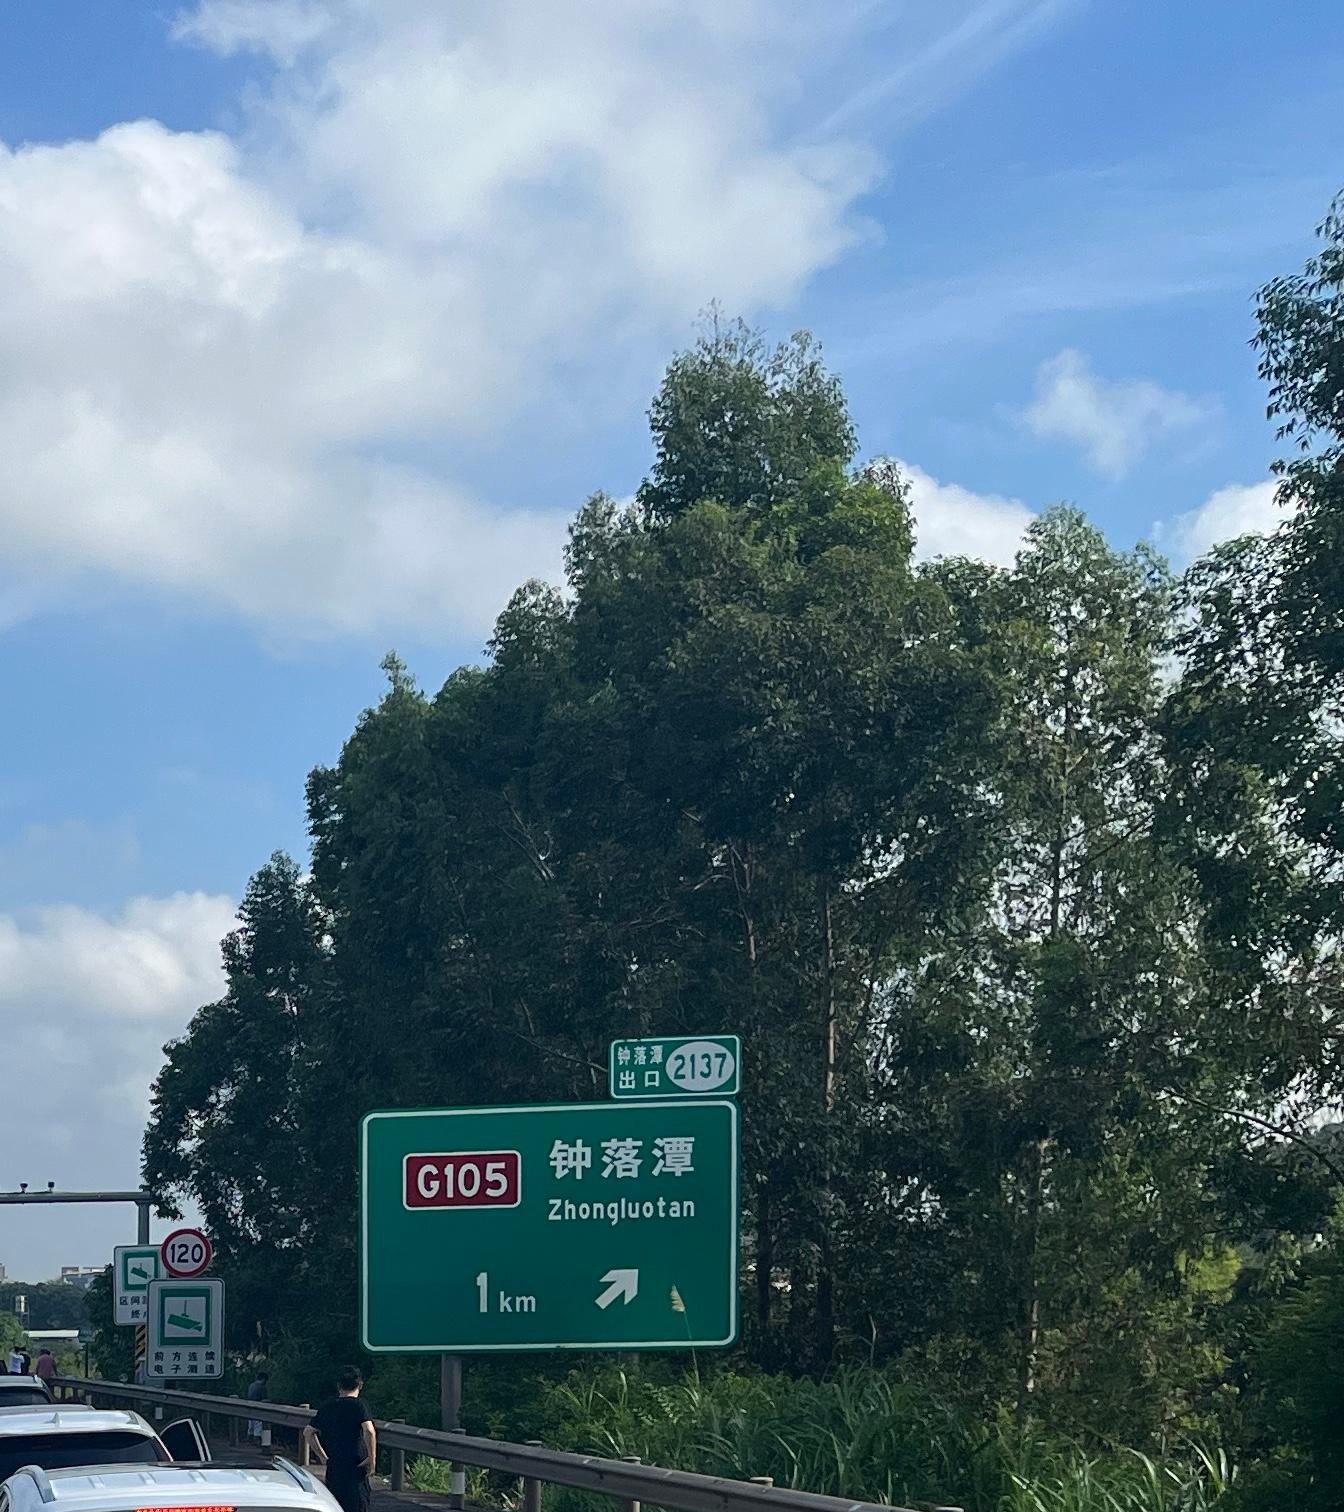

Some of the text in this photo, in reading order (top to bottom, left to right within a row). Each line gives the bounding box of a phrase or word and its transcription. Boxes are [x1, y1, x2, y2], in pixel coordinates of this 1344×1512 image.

[617, 1044, 664, 1066] 钟落潭
[673, 1052, 728, 1081] 2137
[618, 1070, 661, 1090] 出口
[548, 1136, 696, 1180] 钟落潭
[416, 1162, 509, 1199] G105
[548, 1196, 696, 1226] Zhongluotan
[170, 1243, 204, 1264] 120
